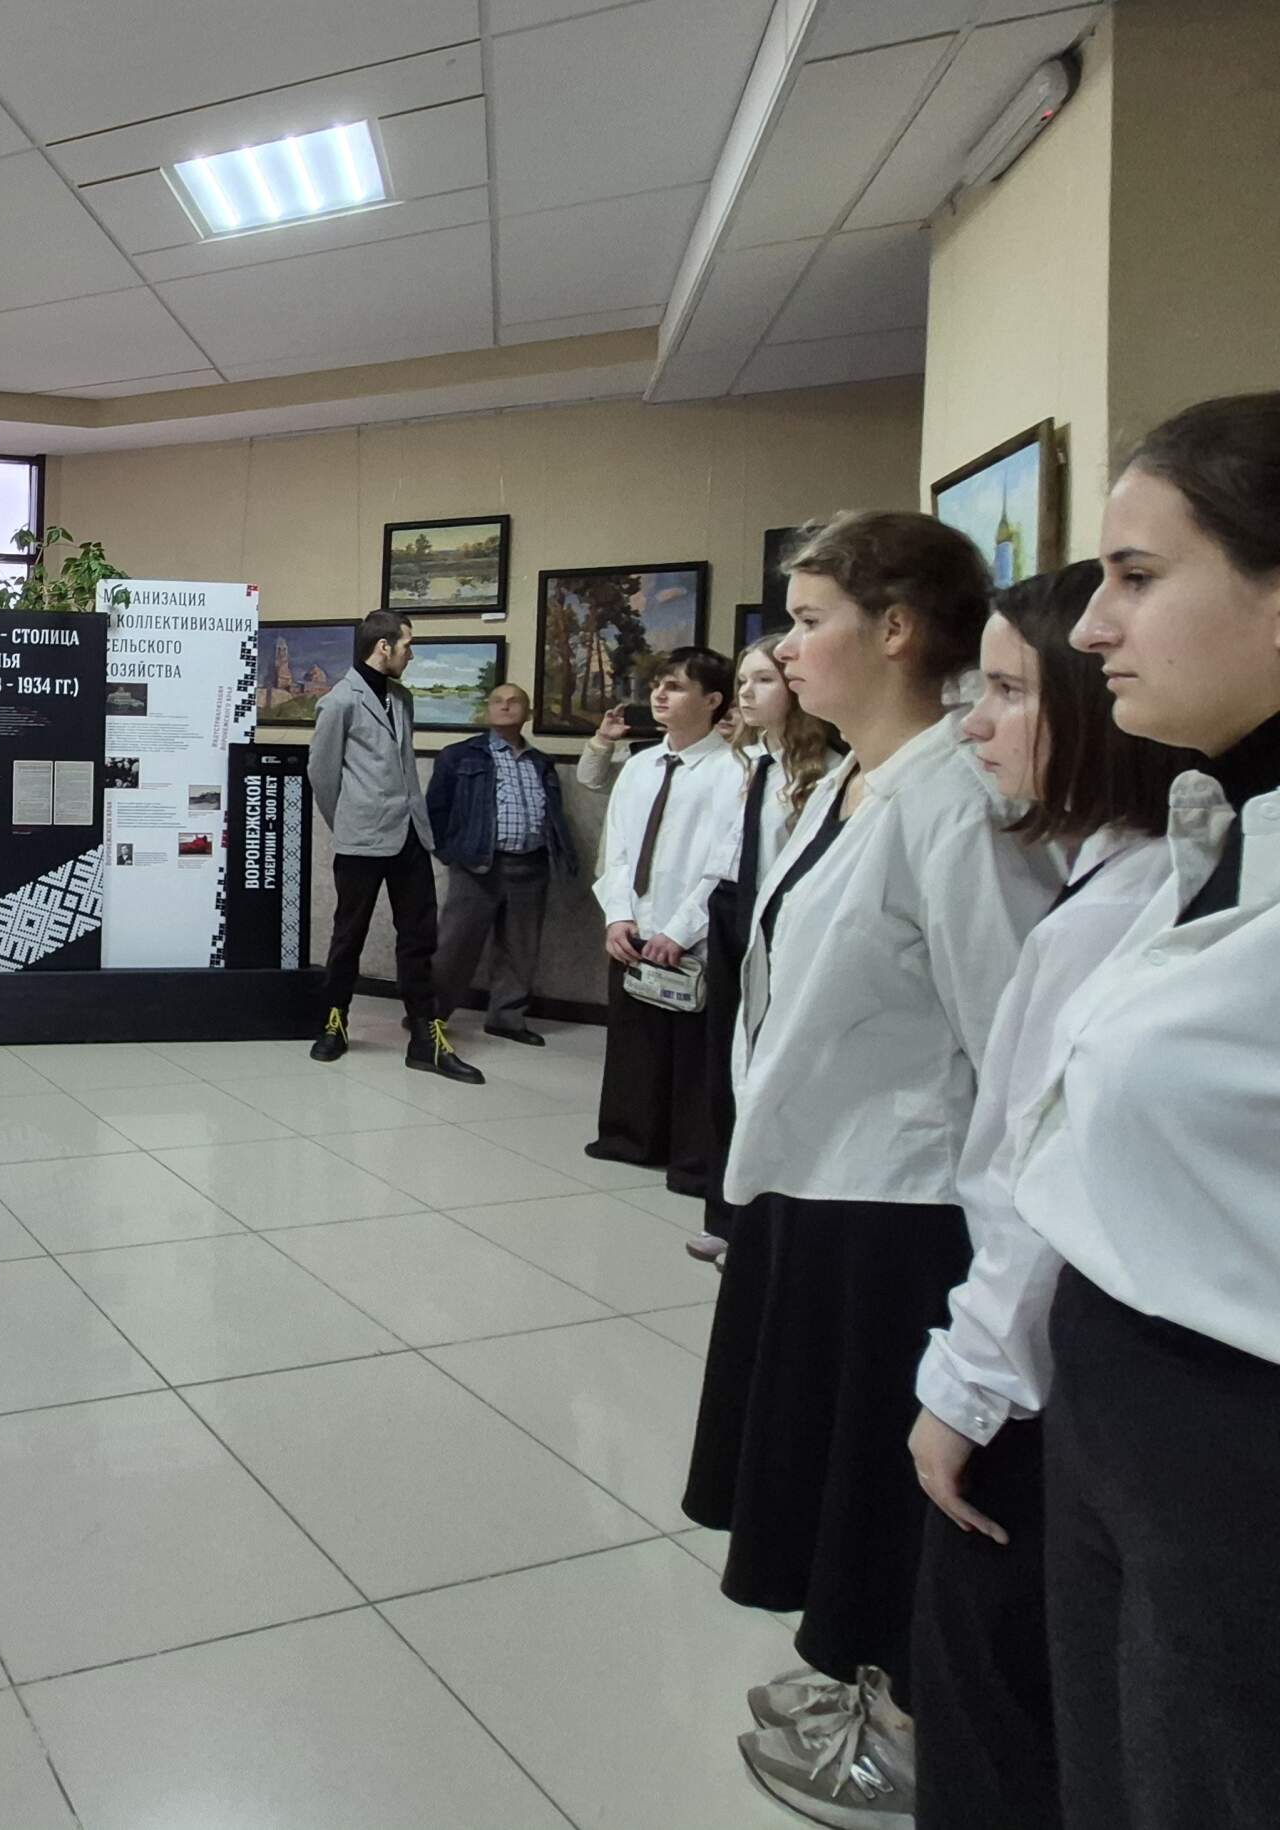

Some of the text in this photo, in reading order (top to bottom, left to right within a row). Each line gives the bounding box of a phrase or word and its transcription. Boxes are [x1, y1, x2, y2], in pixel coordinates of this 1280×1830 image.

[103, 588, 206, 607] МАНИЗАЦИЯ
[117, 614, 252, 633] КОЛЛЕКТИВИЗАЦИЯ
[11, 628, 80, 646] СТОЛИЦА
[17, 676, 51, 695] 1934
[265, 775, 278, 793] ЛЕТ
[265, 796, 278, 821] 300
[244, 775, 262, 889] ВОРОНЕЖСКОЙ
[264, 832, 277, 889] ГУБЕРНИИ
